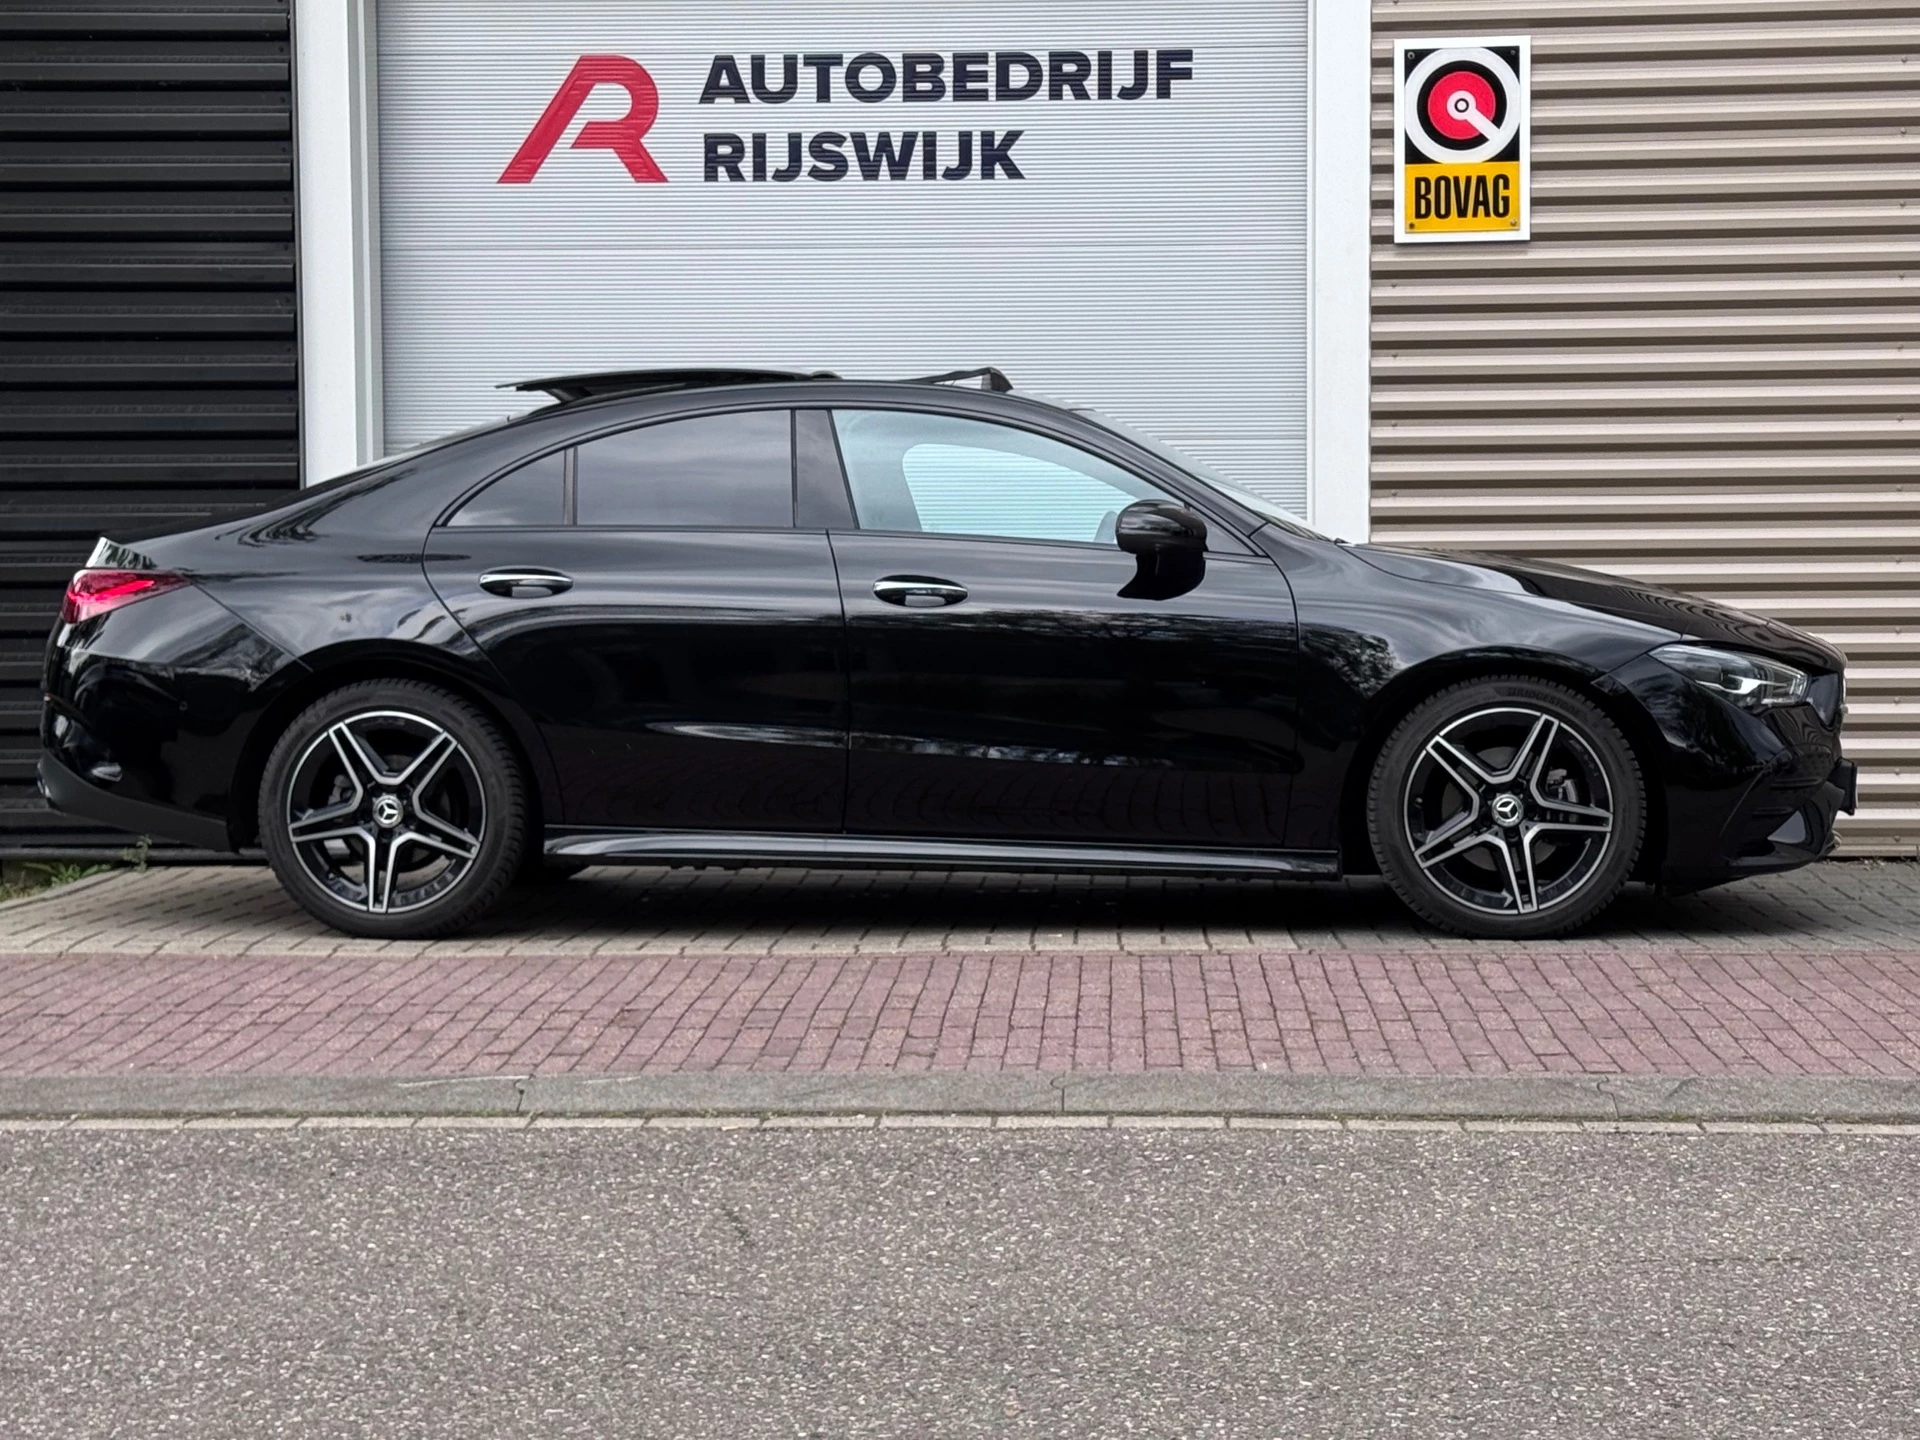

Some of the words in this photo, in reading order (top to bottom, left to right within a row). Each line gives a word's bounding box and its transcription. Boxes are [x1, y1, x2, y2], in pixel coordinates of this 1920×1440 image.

[699, 49, 1194, 105] AUTOBEDRIJF
[704, 129, 1026, 183] RIJSWIJK
[1414, 173, 1511, 220] BOVAG
